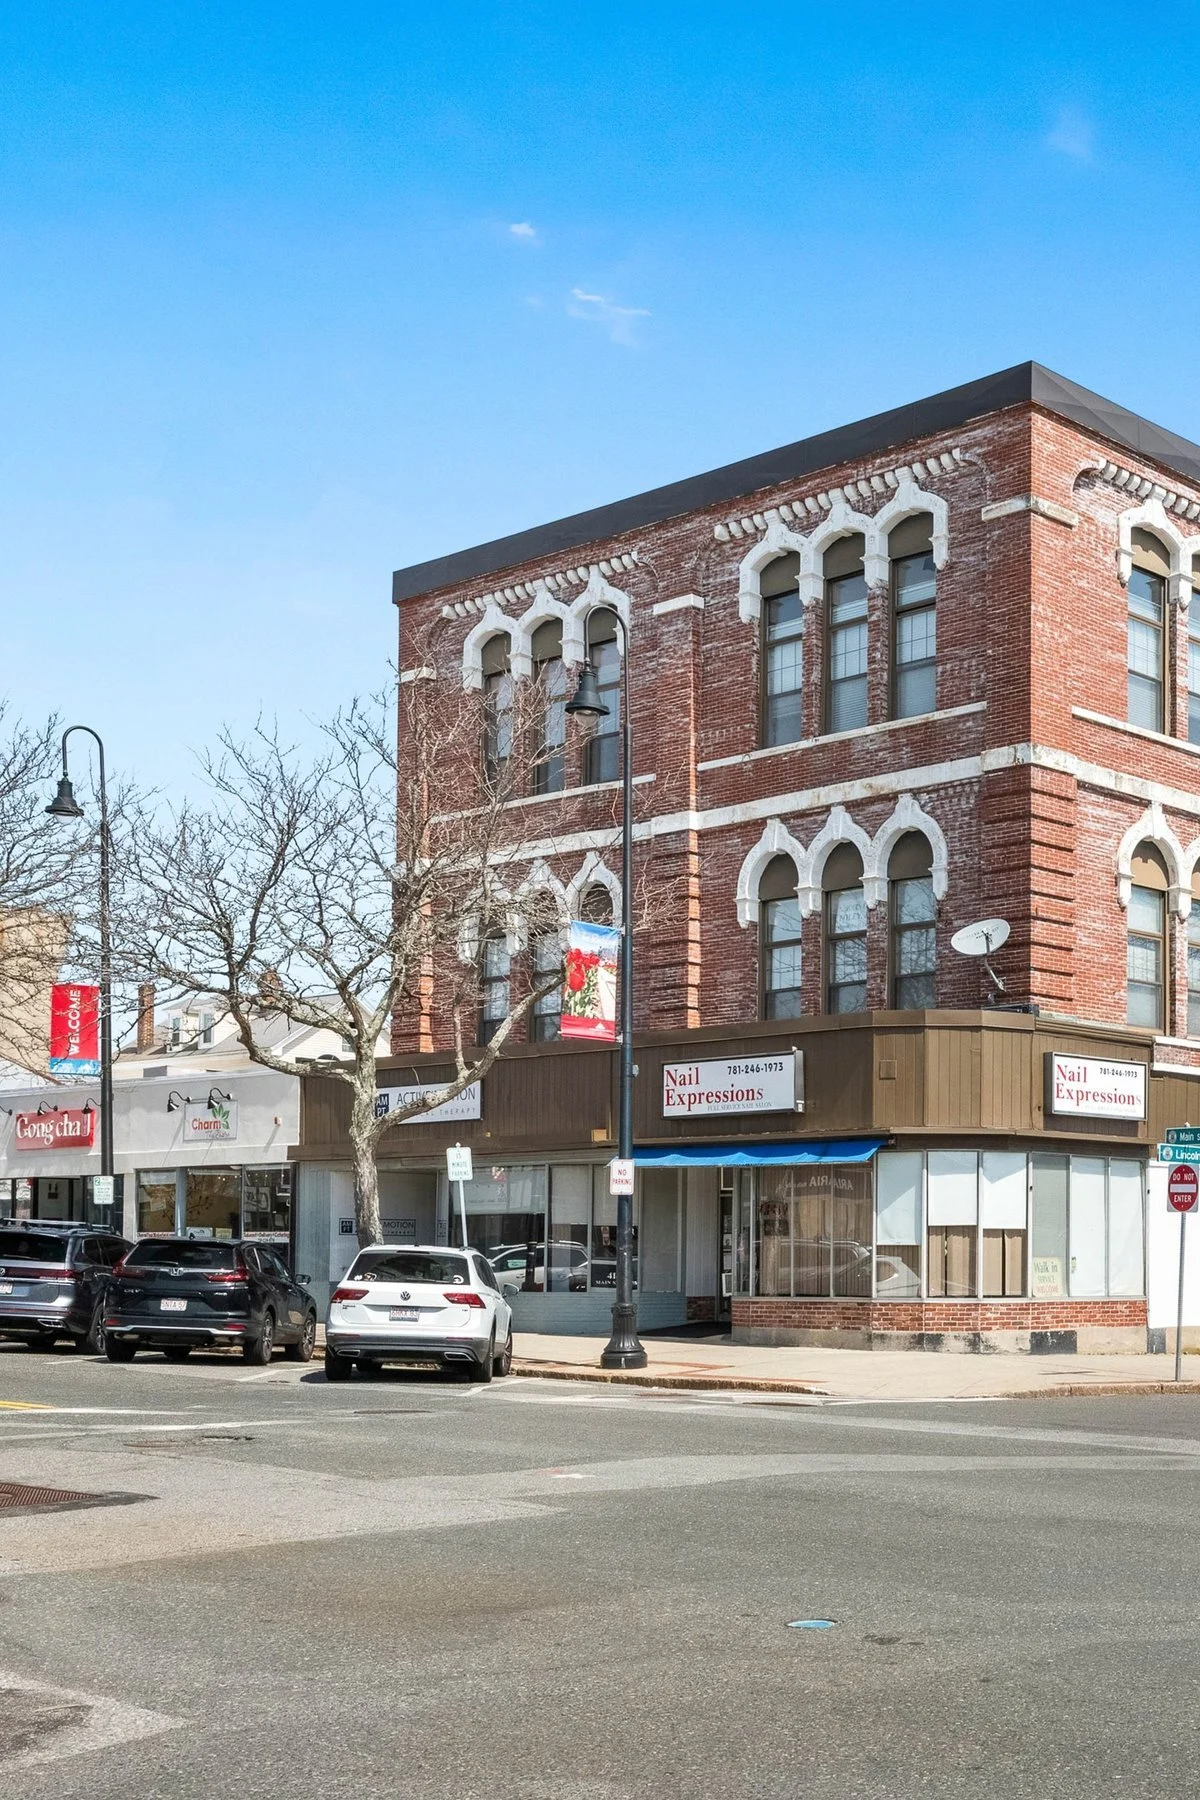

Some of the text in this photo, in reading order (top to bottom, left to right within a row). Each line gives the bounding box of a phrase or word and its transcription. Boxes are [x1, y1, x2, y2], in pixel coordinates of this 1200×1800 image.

[68, 989, 82, 1056] WELCOME
[665, 1062, 784, 1087] Nail 781-246-1973
[1056, 1064, 1138, 1083] Nail 781-246-1973
[665, 1083, 764, 1112] Expressions
[1056, 1083, 1142, 1107] Expressions
[17, 1113, 81, 1145] Gong cha
[191, 1118, 222, 1131] Charm
[1180, 1132, 1194, 1141] Main
[1172, 1173, 1195, 1181] DO NOT
[1173, 1194, 1192, 1203] ENTER
[1033, 1261, 1058, 1273] Walk in
